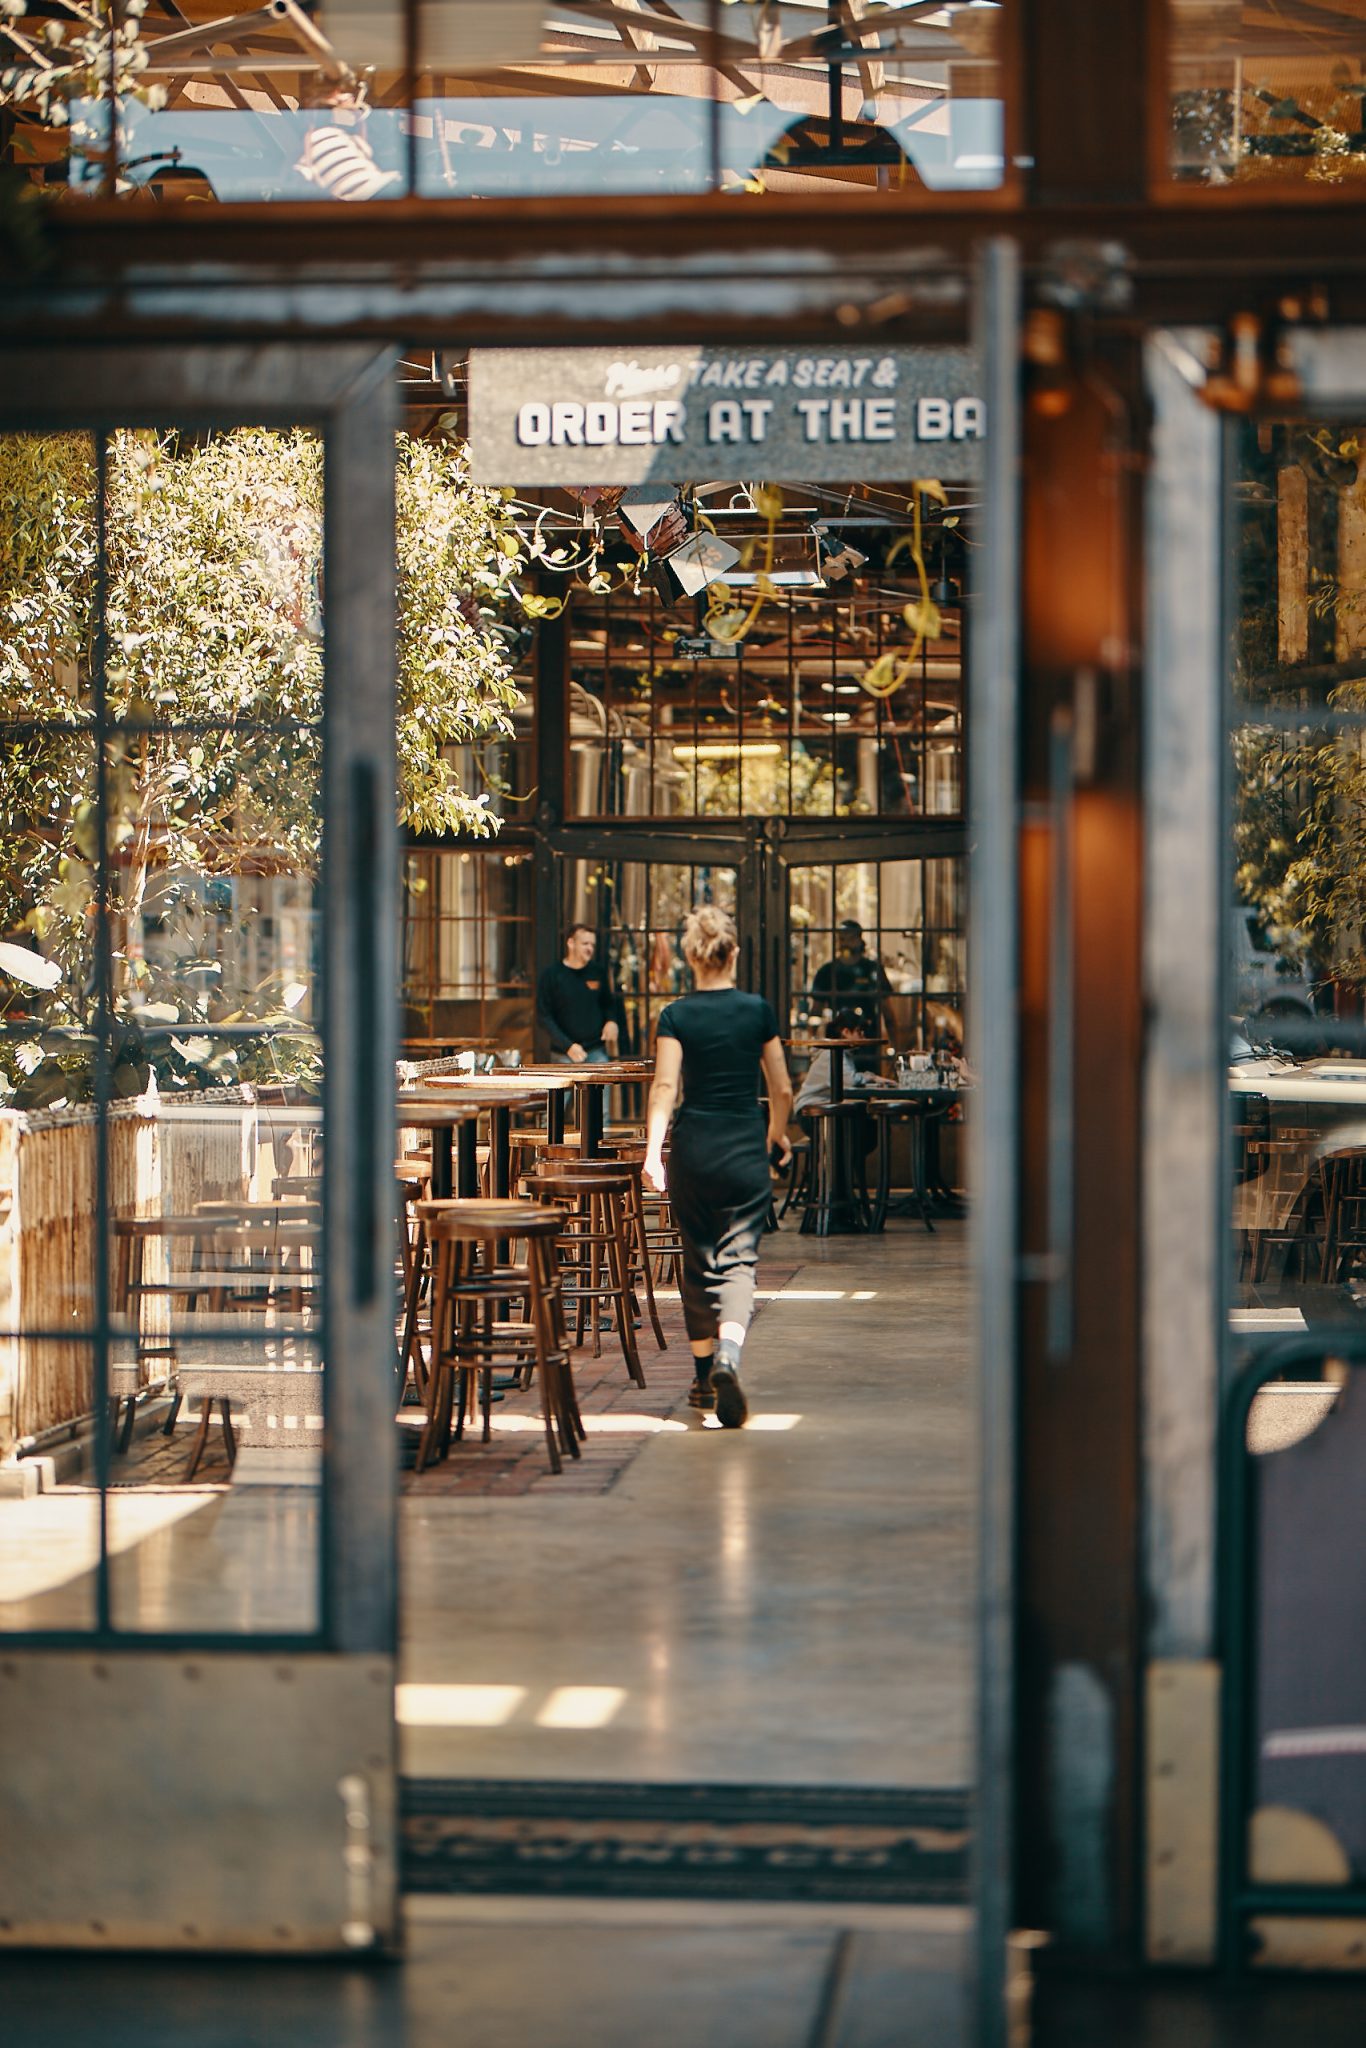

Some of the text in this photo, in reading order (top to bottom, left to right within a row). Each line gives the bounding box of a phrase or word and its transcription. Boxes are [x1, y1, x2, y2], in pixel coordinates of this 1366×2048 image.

[688, 360, 766, 388] TAKE
[765, 360, 787, 387] A
[792, 359, 870, 388] SEAT
[872, 358, 898, 388] &
[517, 401, 686, 445] ORDER
[708, 400, 774, 442] AT
[797, 398, 896, 441] THE
